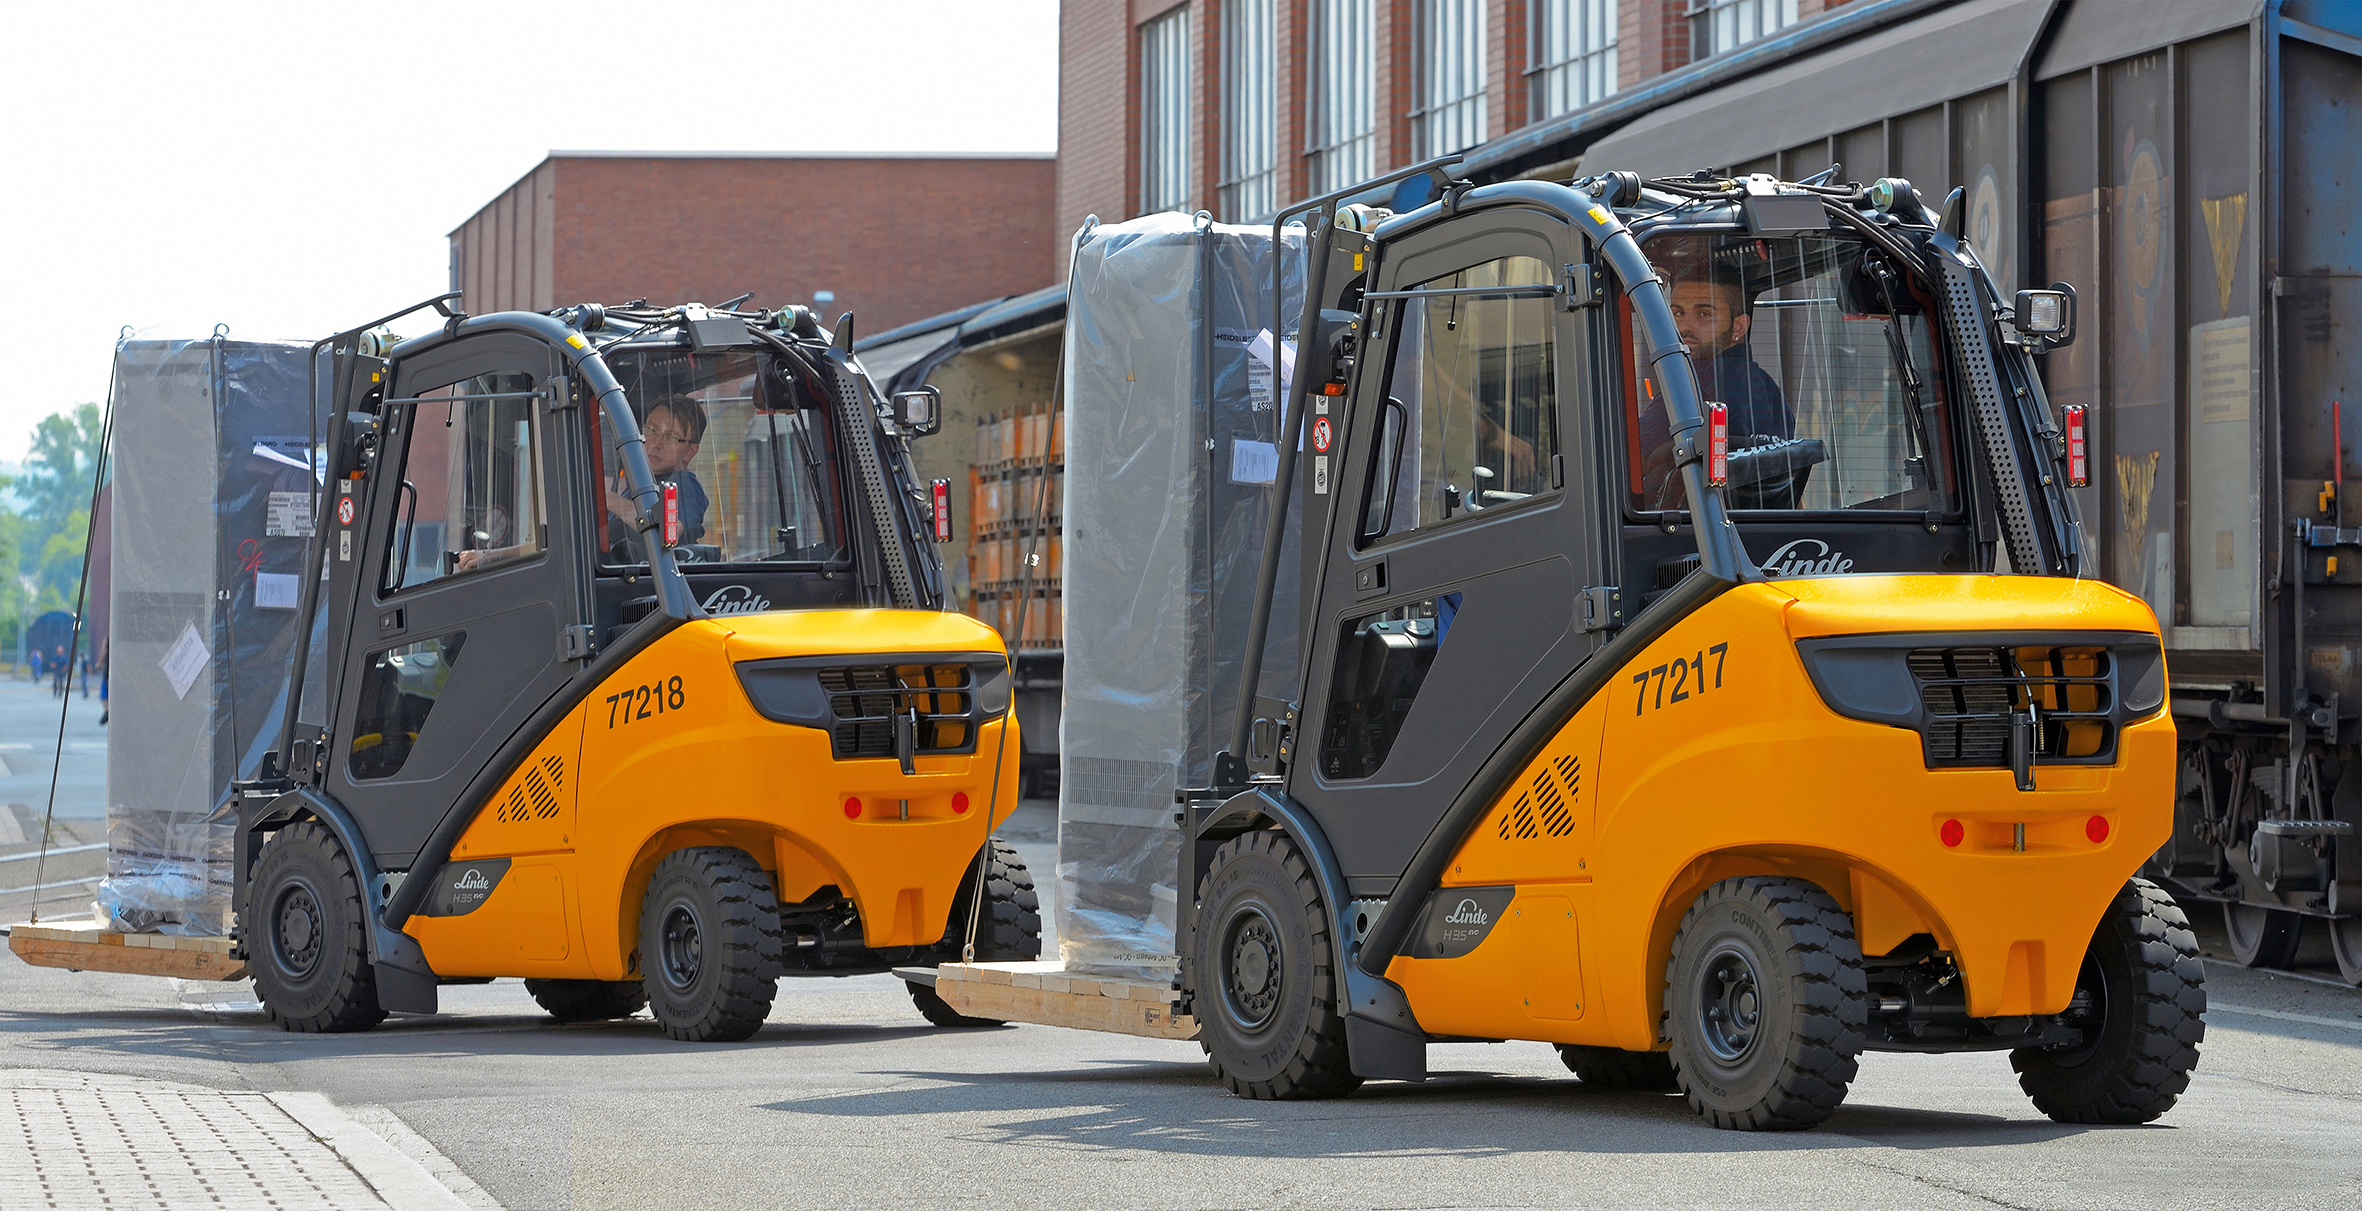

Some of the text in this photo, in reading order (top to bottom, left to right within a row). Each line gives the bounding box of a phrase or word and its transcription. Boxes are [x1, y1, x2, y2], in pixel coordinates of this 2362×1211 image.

[1760, 539, 1854, 575] Linde
[700, 585, 770, 614] Linde
[1633, 641, 1728, 717] 77217
[606, 675, 685, 729] 77218
[453, 868, 489, 890] Linde
[1229, 869, 1240, 885] 15
[1445, 898, 1488, 925] Linde
[1731, 909, 1787, 1003] CONTINENTAL
[1260, 923, 1311, 1070] CONTINENTAL
